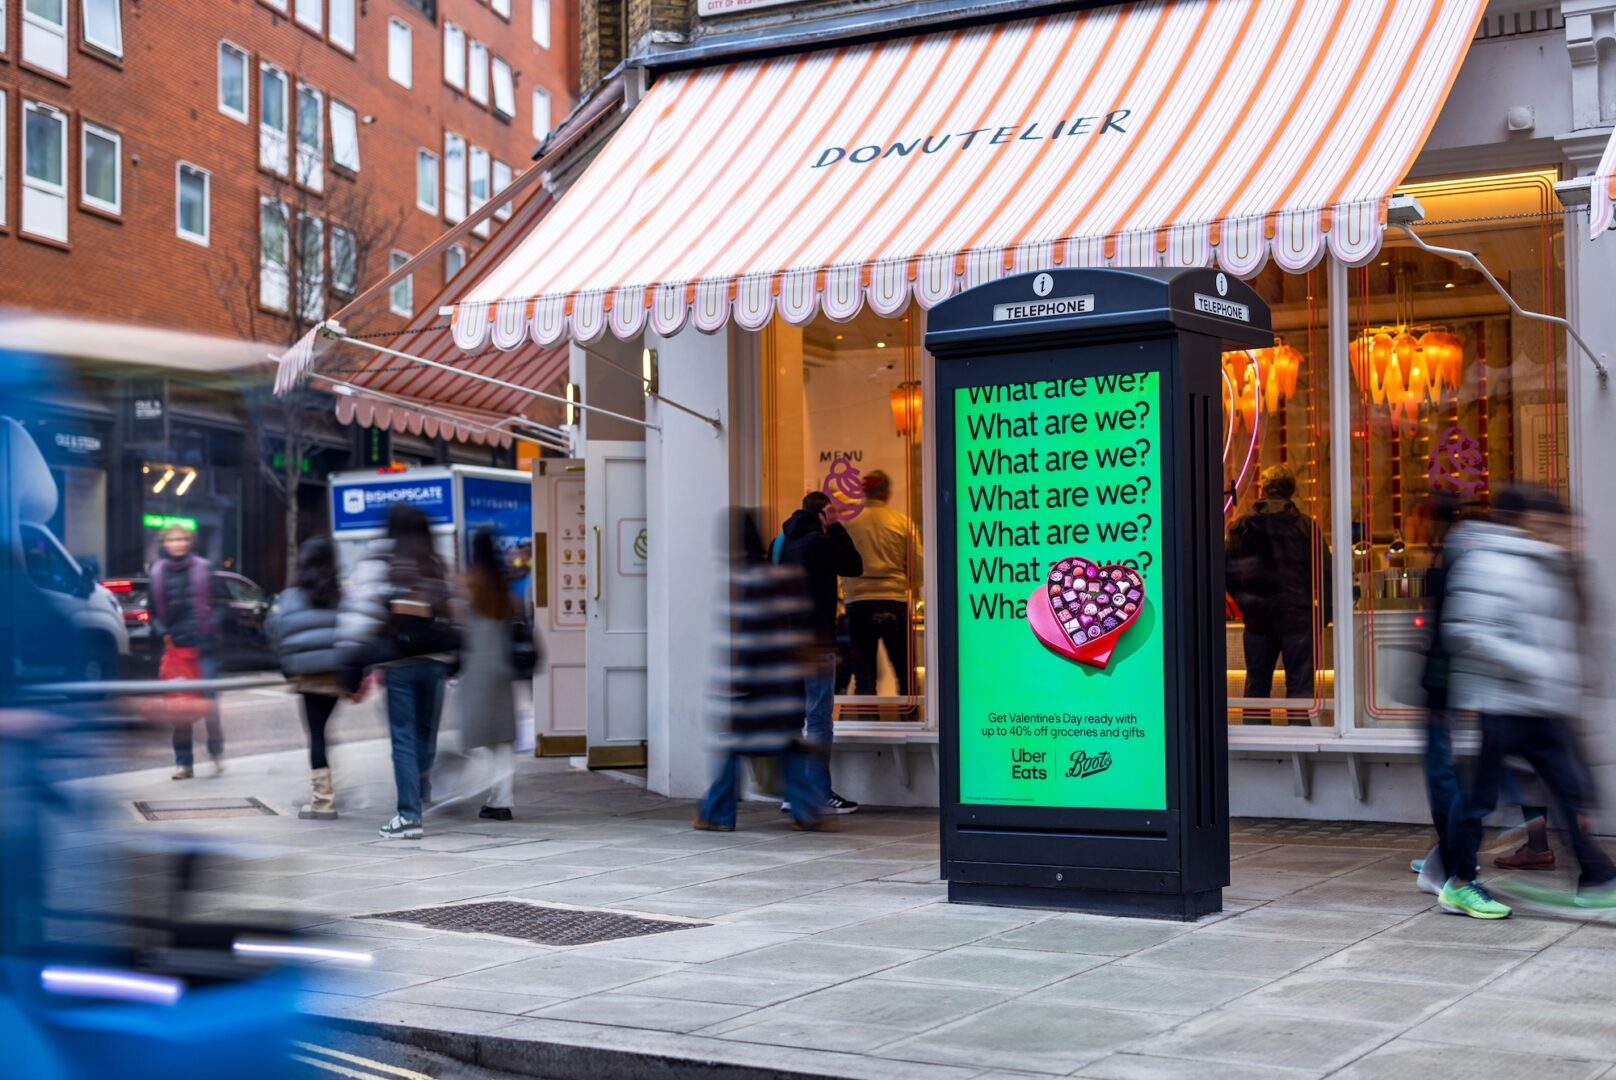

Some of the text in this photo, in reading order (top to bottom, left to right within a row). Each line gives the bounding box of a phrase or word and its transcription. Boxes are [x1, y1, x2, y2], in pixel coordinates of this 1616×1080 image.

[707, 1, 723, 10] CITY
[811, 109, 1131, 168] DONUTELIER
[1006, 299, 1086, 319] TELEPHONE
[1198, 298, 1243, 320] TELEPHONE
[968, 372, 1149, 405] What are we?
[967, 401, 1150, 440] What are we?
[820, 450, 863, 462] MENU
[967, 438, 1151, 476] What are we?
[968, 476, 1151, 512] What are we?
[968, 513, 1152, 548] What are we?
[969, 556, 1040, 584] What
[969, 593, 1028, 620] Wha
[982, 726, 1145, 740] up to 40% off groceries and gifts
[988, 712, 1137, 727] Get Valentine's Day ready with
[1012, 748, 1047, 763] Uber
[1065, 750, 1112, 778] Boots
[1012, 766, 1047, 780] Eats
